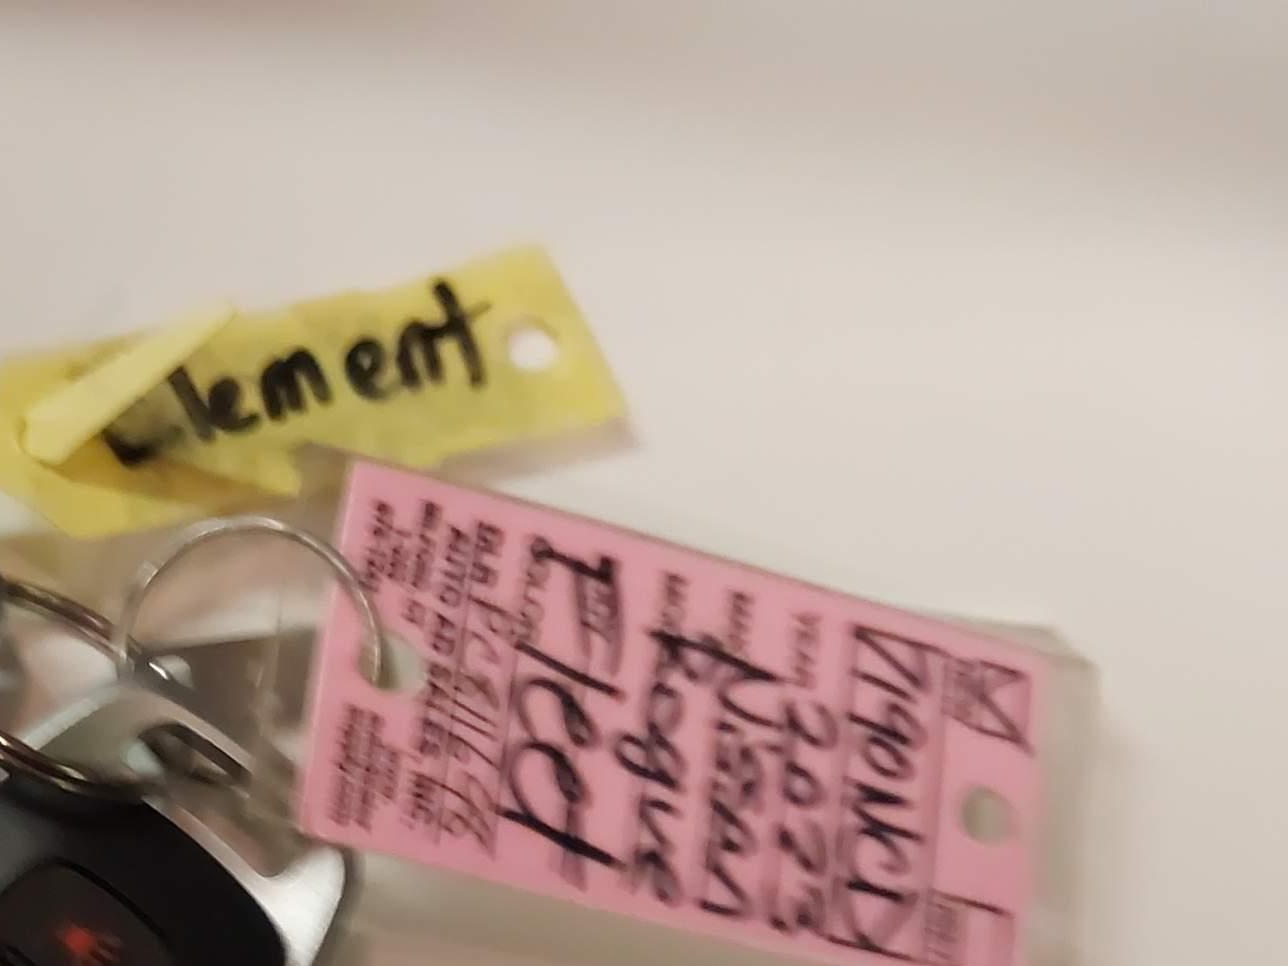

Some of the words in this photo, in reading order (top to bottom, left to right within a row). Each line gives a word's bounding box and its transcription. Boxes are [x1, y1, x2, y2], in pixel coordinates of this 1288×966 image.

[431, 611, 457, 659] AD
[438, 526, 468, 609] AUTO
[488, 546, 626, 889] Fleet
[616, 629, 720, 904] Rogue
[699, 643, 788, 919] Nissan
[770, 701, 840, 932] 2023
